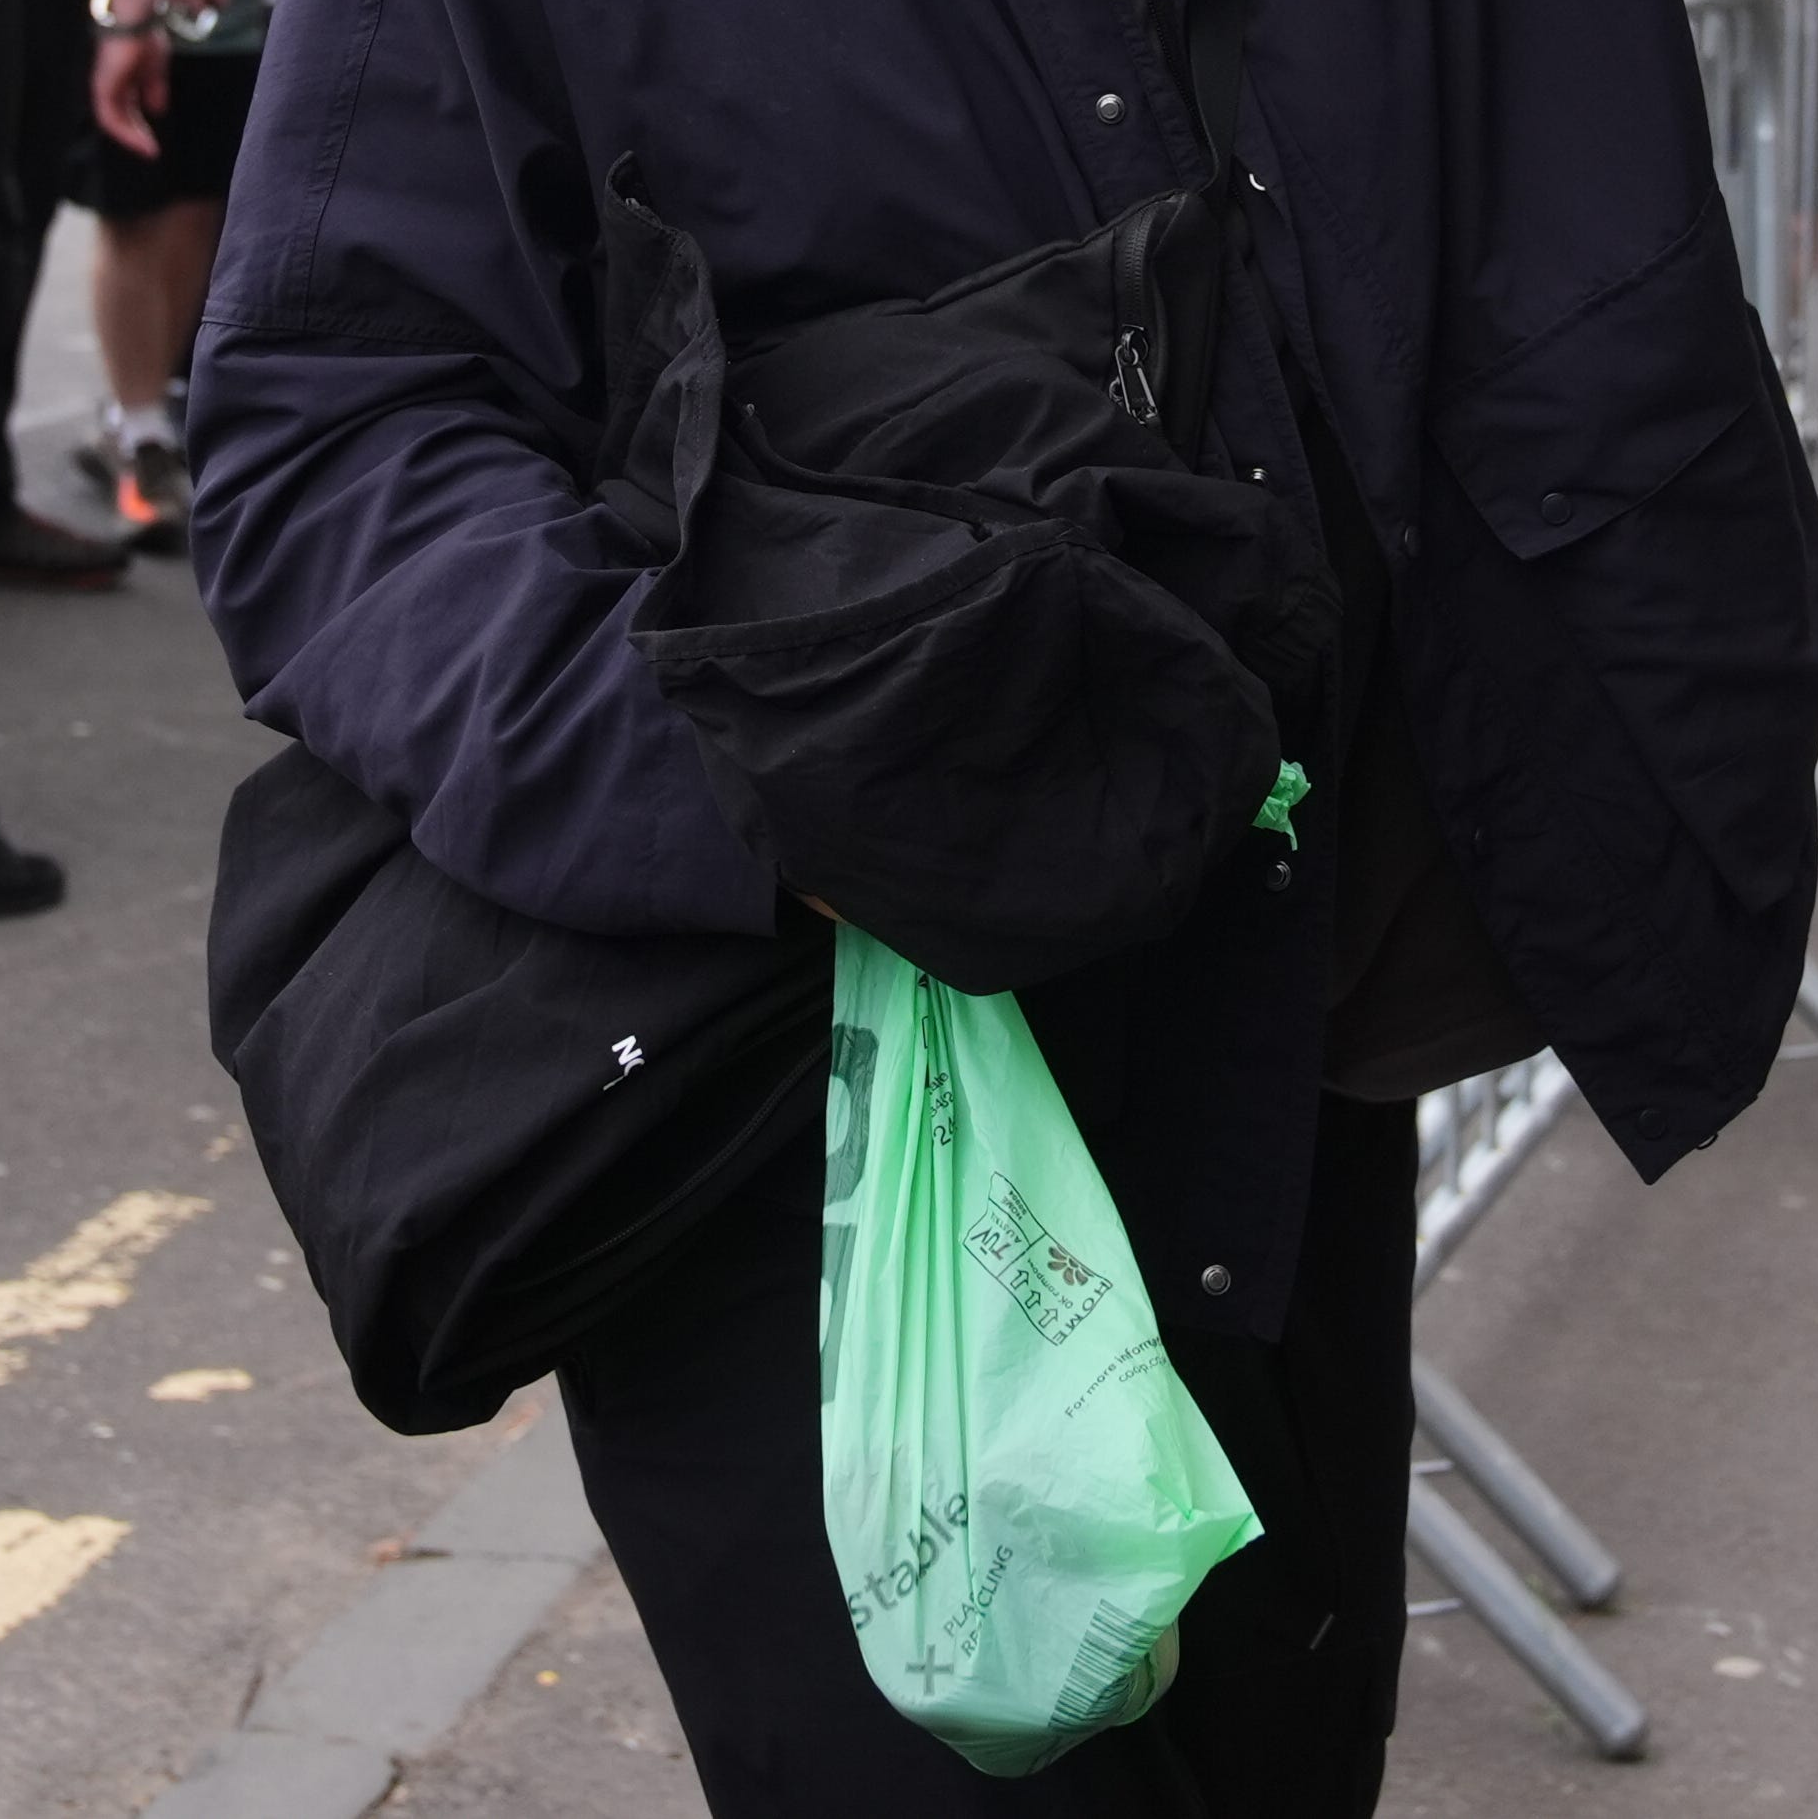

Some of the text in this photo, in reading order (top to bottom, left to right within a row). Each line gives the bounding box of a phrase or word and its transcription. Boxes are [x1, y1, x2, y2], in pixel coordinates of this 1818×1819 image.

[1053, 1281, 1111, 1345] HOME
[1064, 1395, 1086, 1418] For
[1086, 1363, 1117, 1395] more
